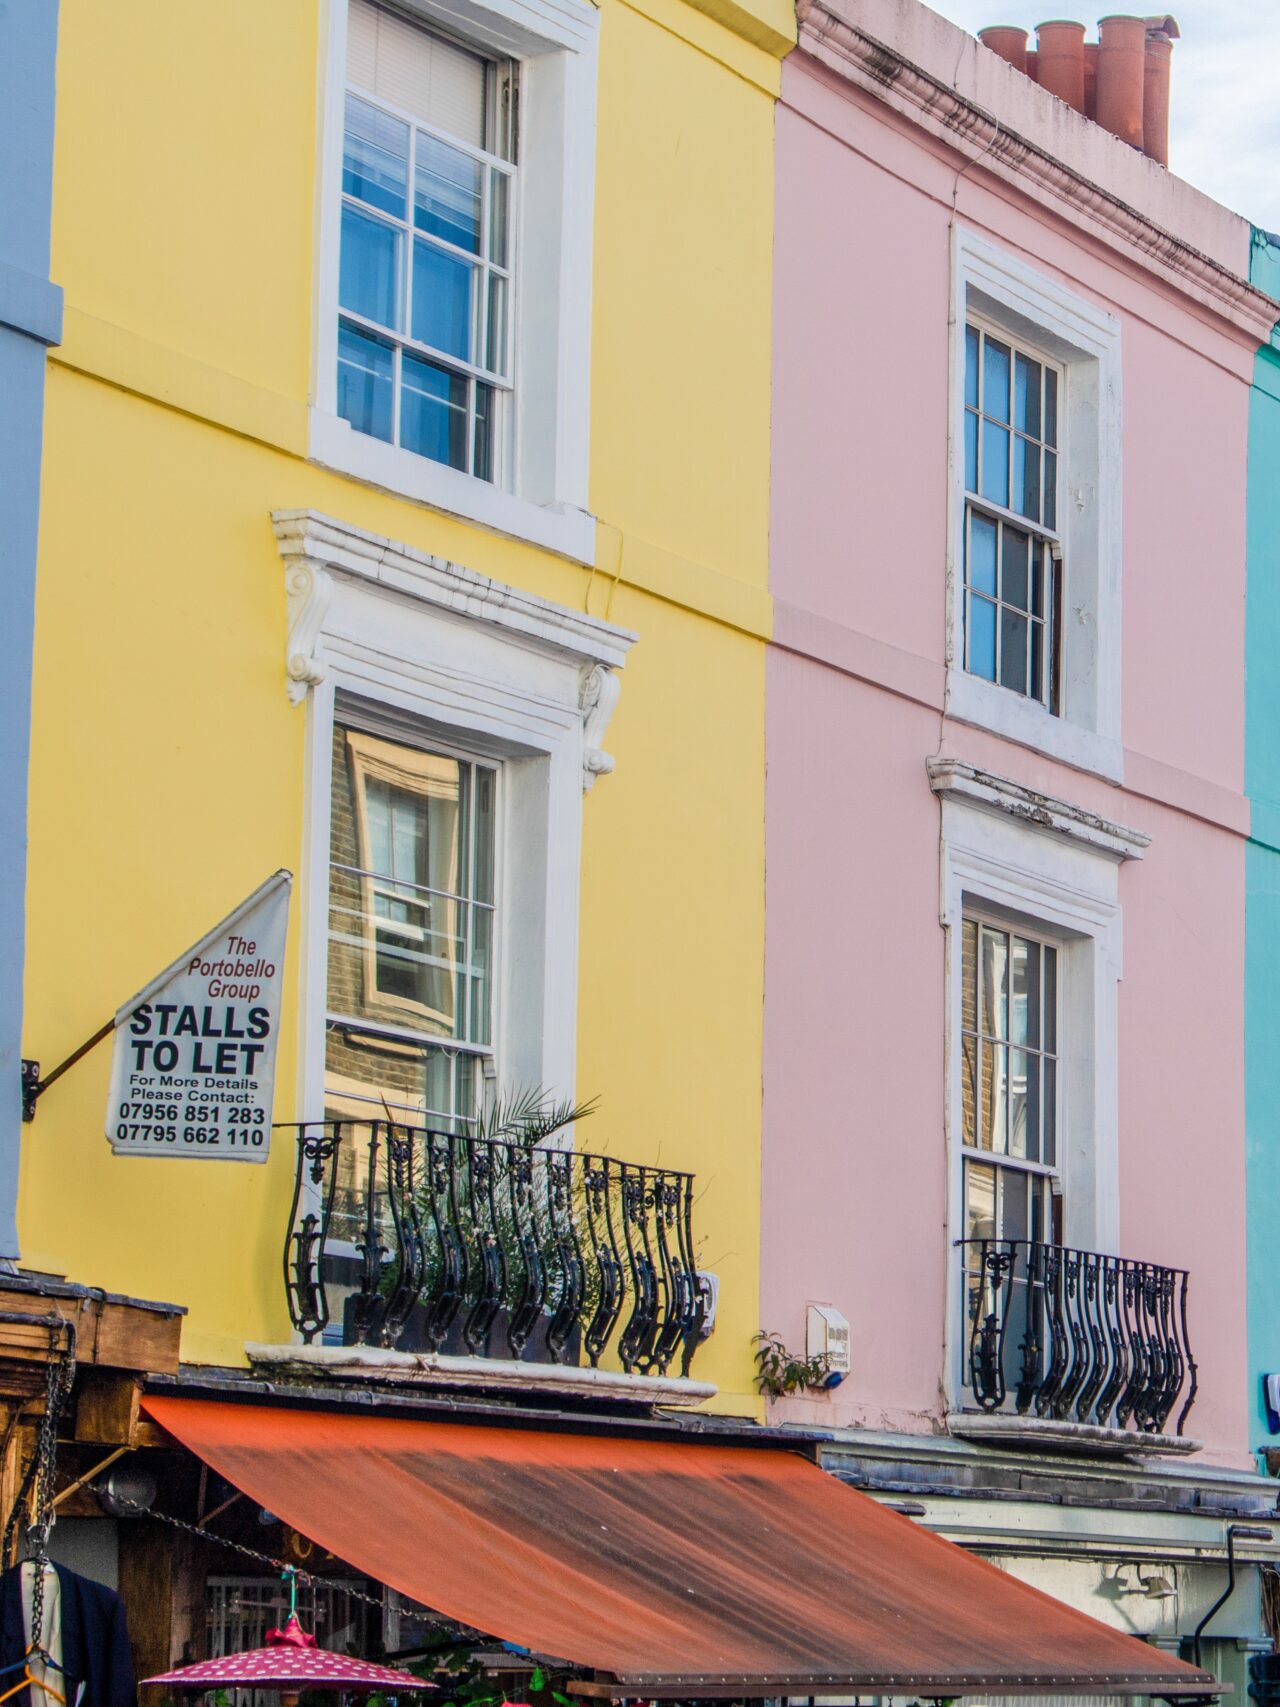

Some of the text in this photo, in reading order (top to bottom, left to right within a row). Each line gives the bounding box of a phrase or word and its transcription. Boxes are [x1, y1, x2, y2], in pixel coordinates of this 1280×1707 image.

[227, 936, 256, 955] The
[188, 957, 275, 978] Portobello
[208, 979, 260, 1003] Group
[130, 1004, 270, 1039] STALLS
[131, 1040, 264, 1075] TO LET
[129, 1074, 258, 1090] For More Details
[130, 1088, 255, 1104] Please Contact:
[119, 1103, 265, 1124] 07956 851 283
[116, 1124, 263, 1146] 07795 662 110
